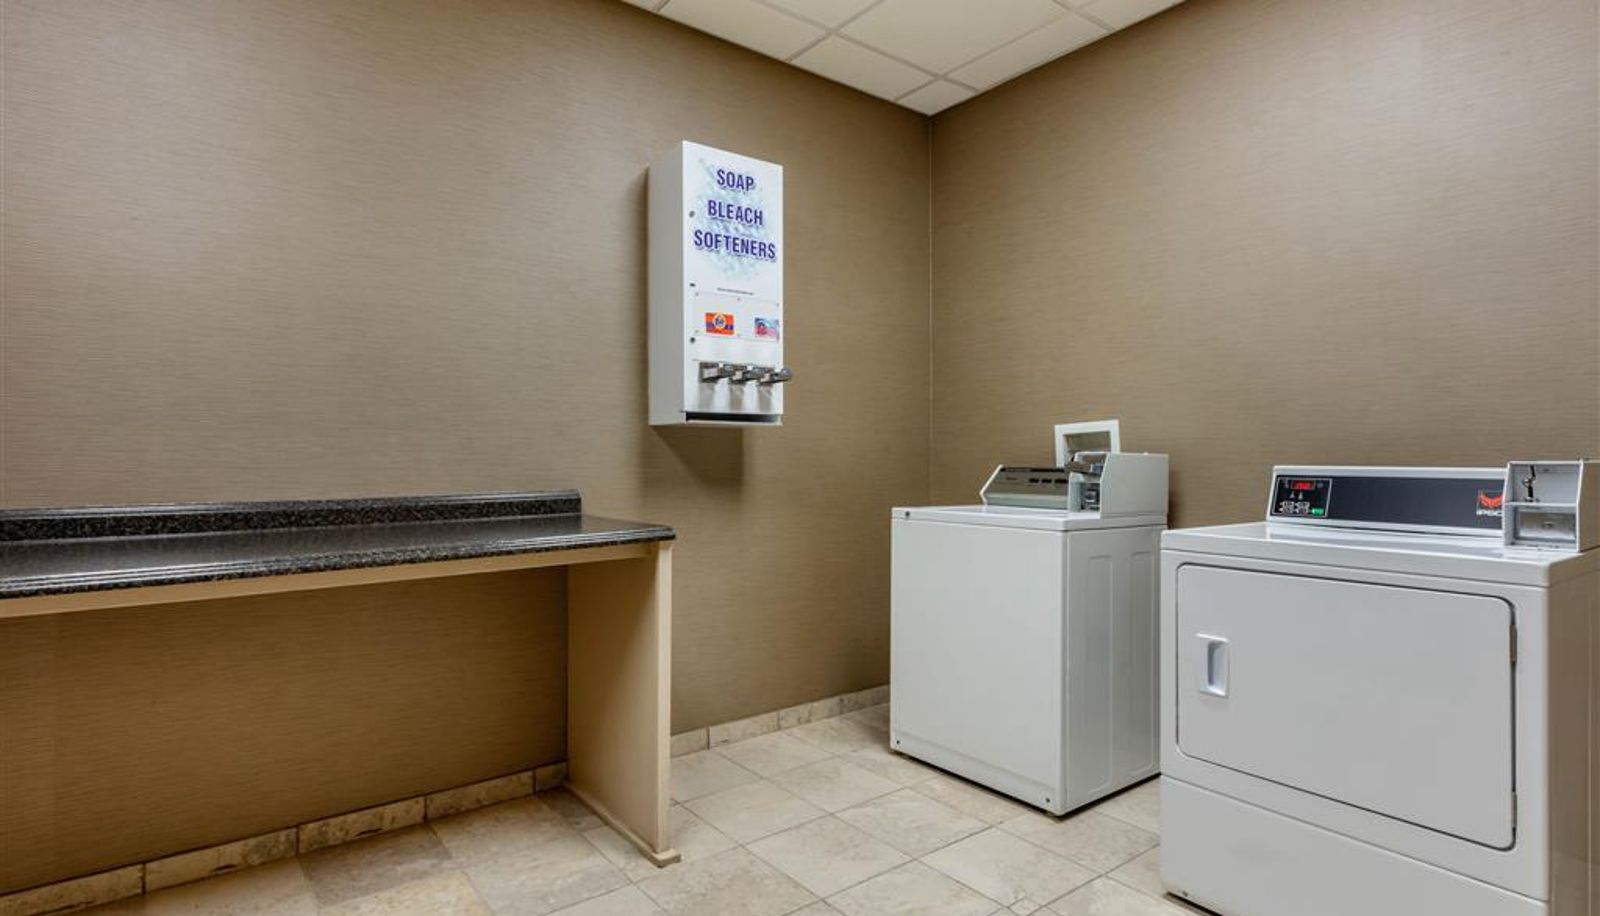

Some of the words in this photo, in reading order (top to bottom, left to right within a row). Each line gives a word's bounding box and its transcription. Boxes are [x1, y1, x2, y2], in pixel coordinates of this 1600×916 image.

[716, 168, 755, 192] SOAP
[707, 199, 764, 226] BLEACH
[694, 229, 777, 260] SOFTENERS
